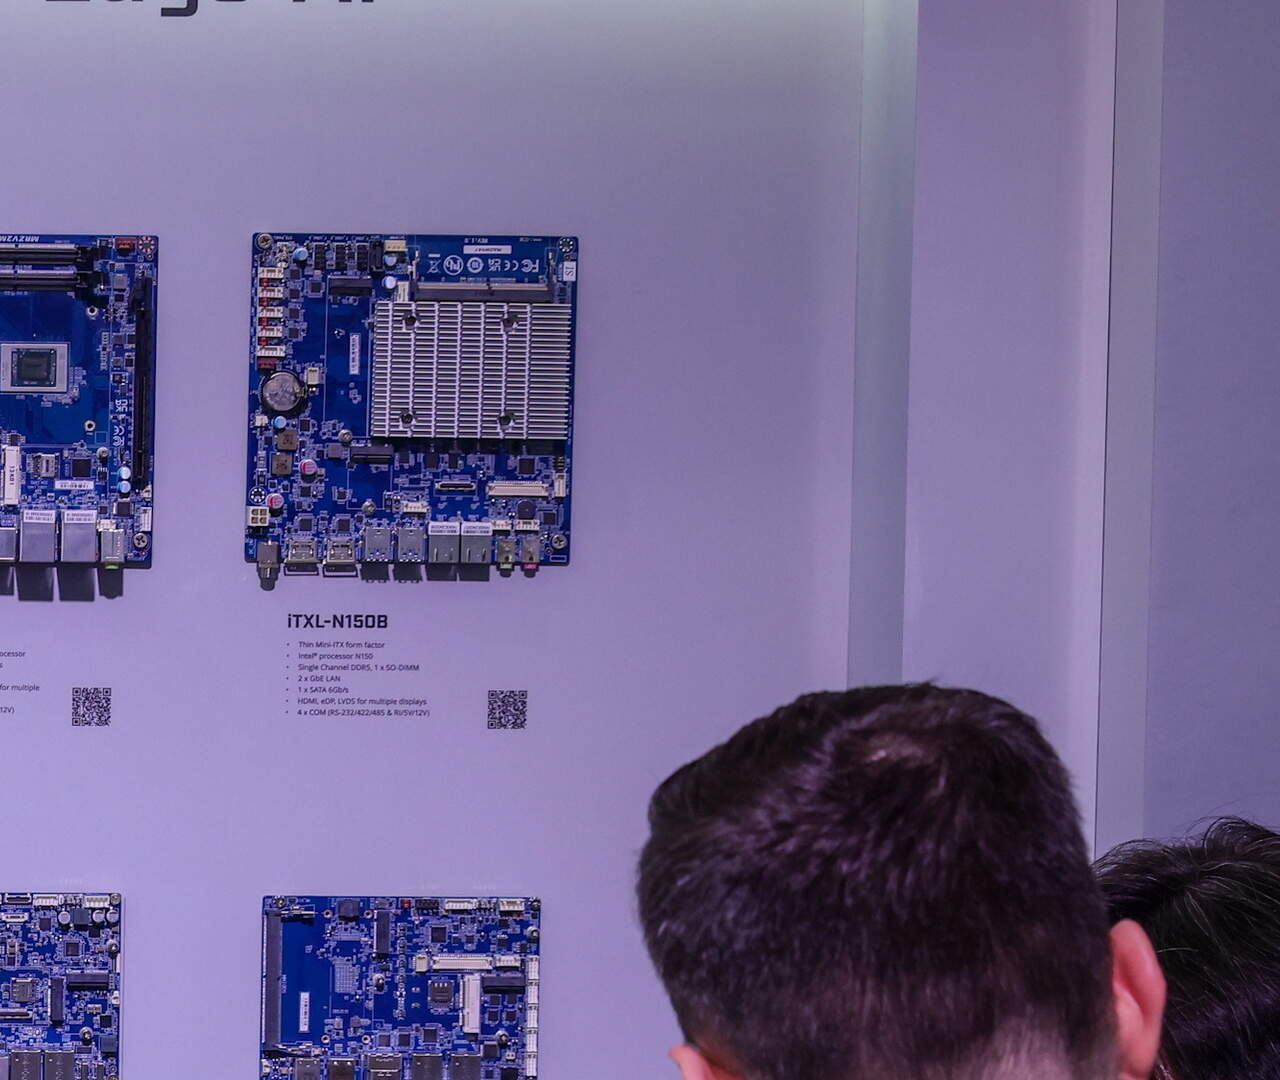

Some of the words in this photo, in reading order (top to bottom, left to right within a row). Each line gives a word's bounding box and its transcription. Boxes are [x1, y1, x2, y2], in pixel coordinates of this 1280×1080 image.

[288, 614, 387, 628] iTXL-N150B
[298, 640, 314, 648] Thin
[315, 640, 344, 648] Mini-ITX
[345, 640, 363, 648] form
[364, 640, 386, 648] factor
